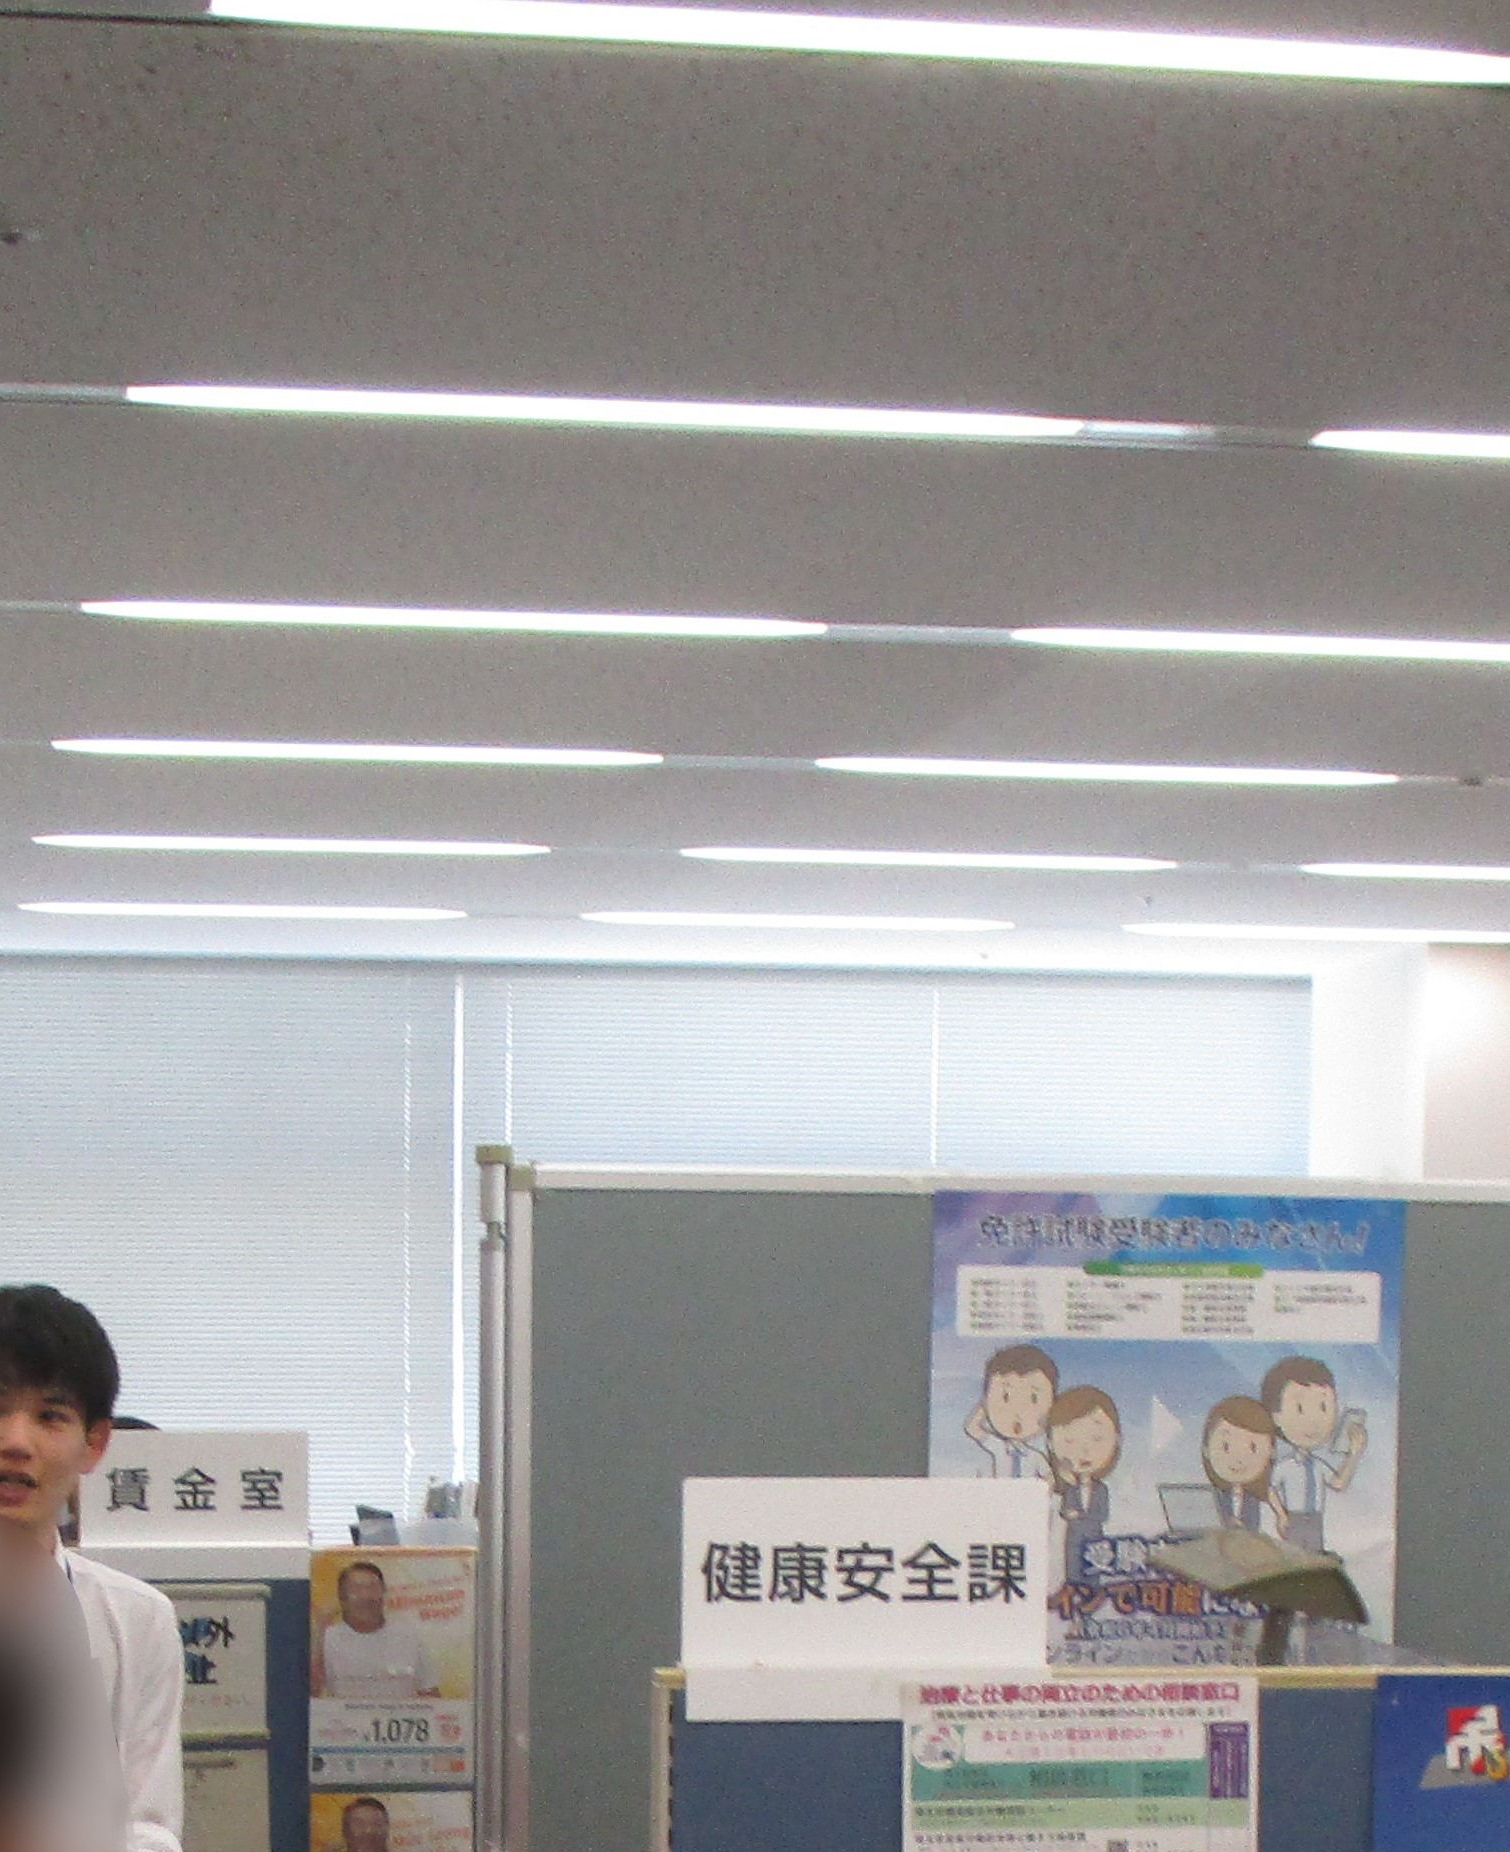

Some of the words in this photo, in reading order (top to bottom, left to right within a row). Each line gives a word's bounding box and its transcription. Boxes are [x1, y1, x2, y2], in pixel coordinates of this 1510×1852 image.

[105, 1466, 284, 1512] 賃金室
[701, 1541, 1027, 1603] 健康安全課
